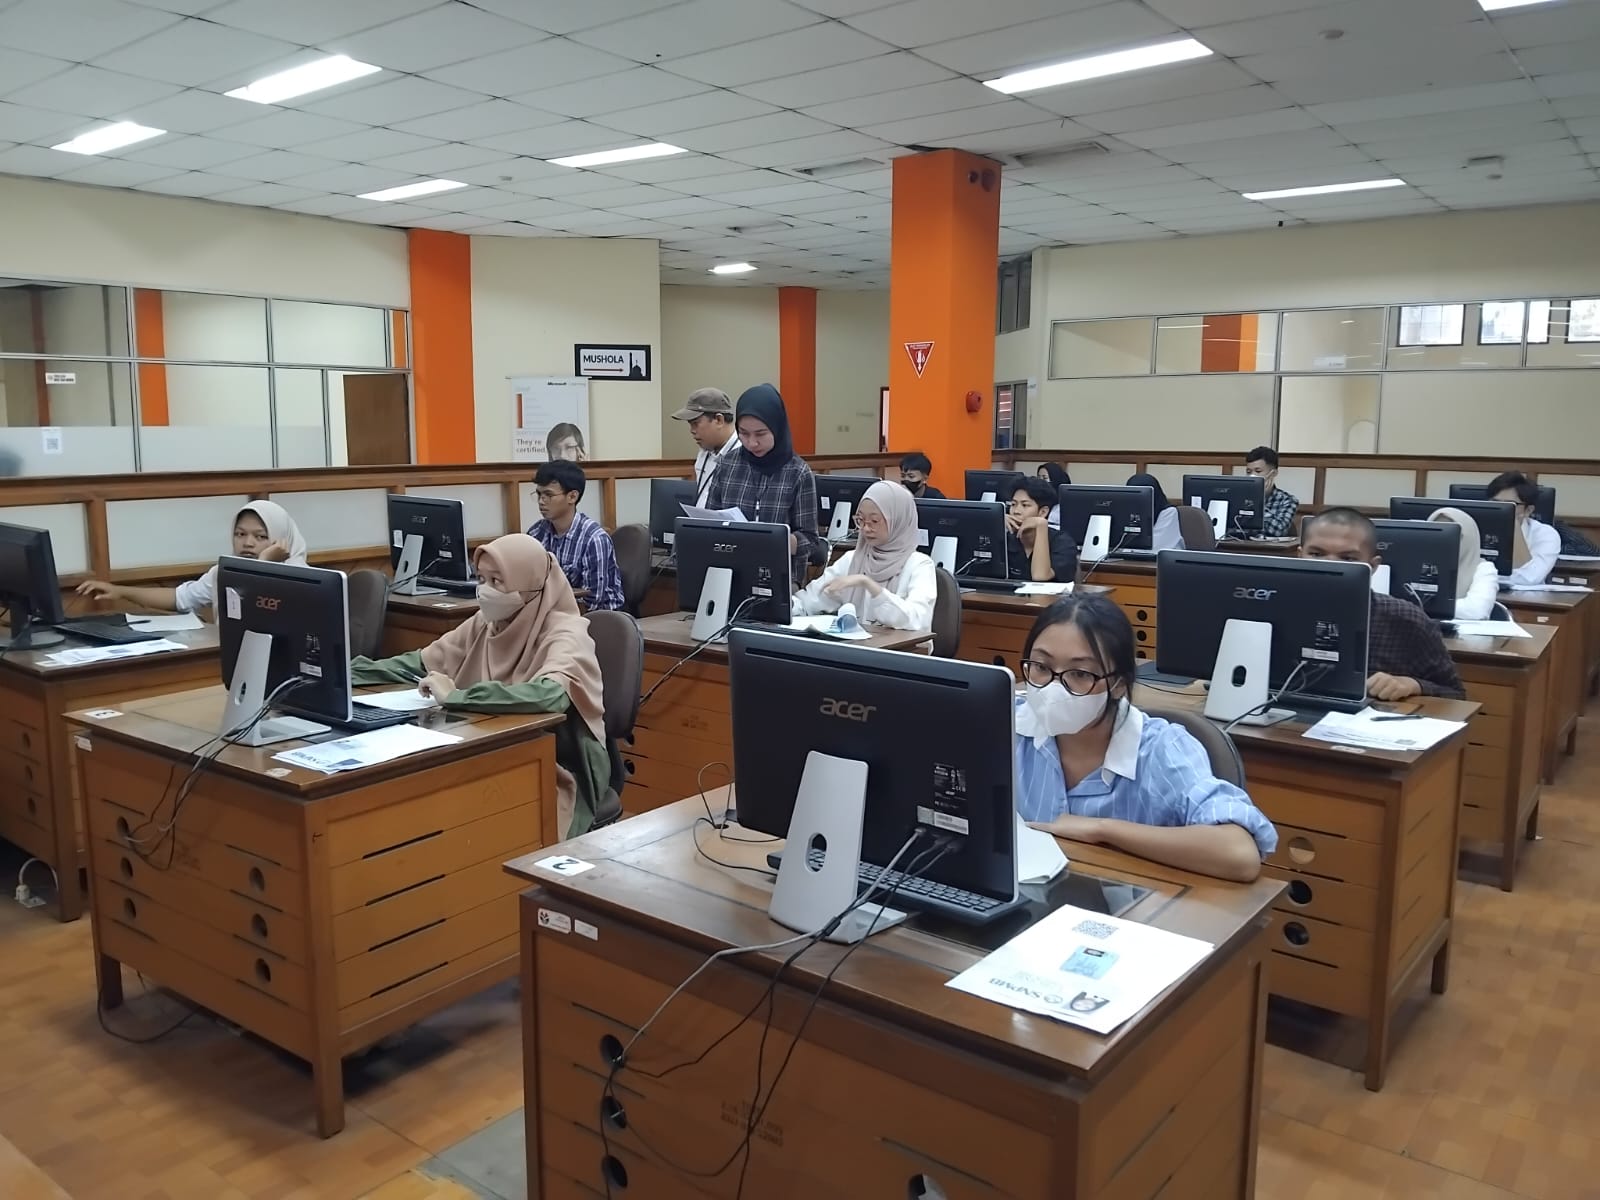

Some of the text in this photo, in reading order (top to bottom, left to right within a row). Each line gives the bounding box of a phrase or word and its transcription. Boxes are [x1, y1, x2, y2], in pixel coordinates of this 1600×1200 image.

[583, 354, 625, 363] MUSHOLA
[713, 543, 737, 552] acer
[1233, 586, 1277, 600] acer
[255, 596, 281, 610] acer
[820, 697, 877, 722] acer
[552, 858, 580, 870] 2
[988, 977, 1041, 999] SNPMB
